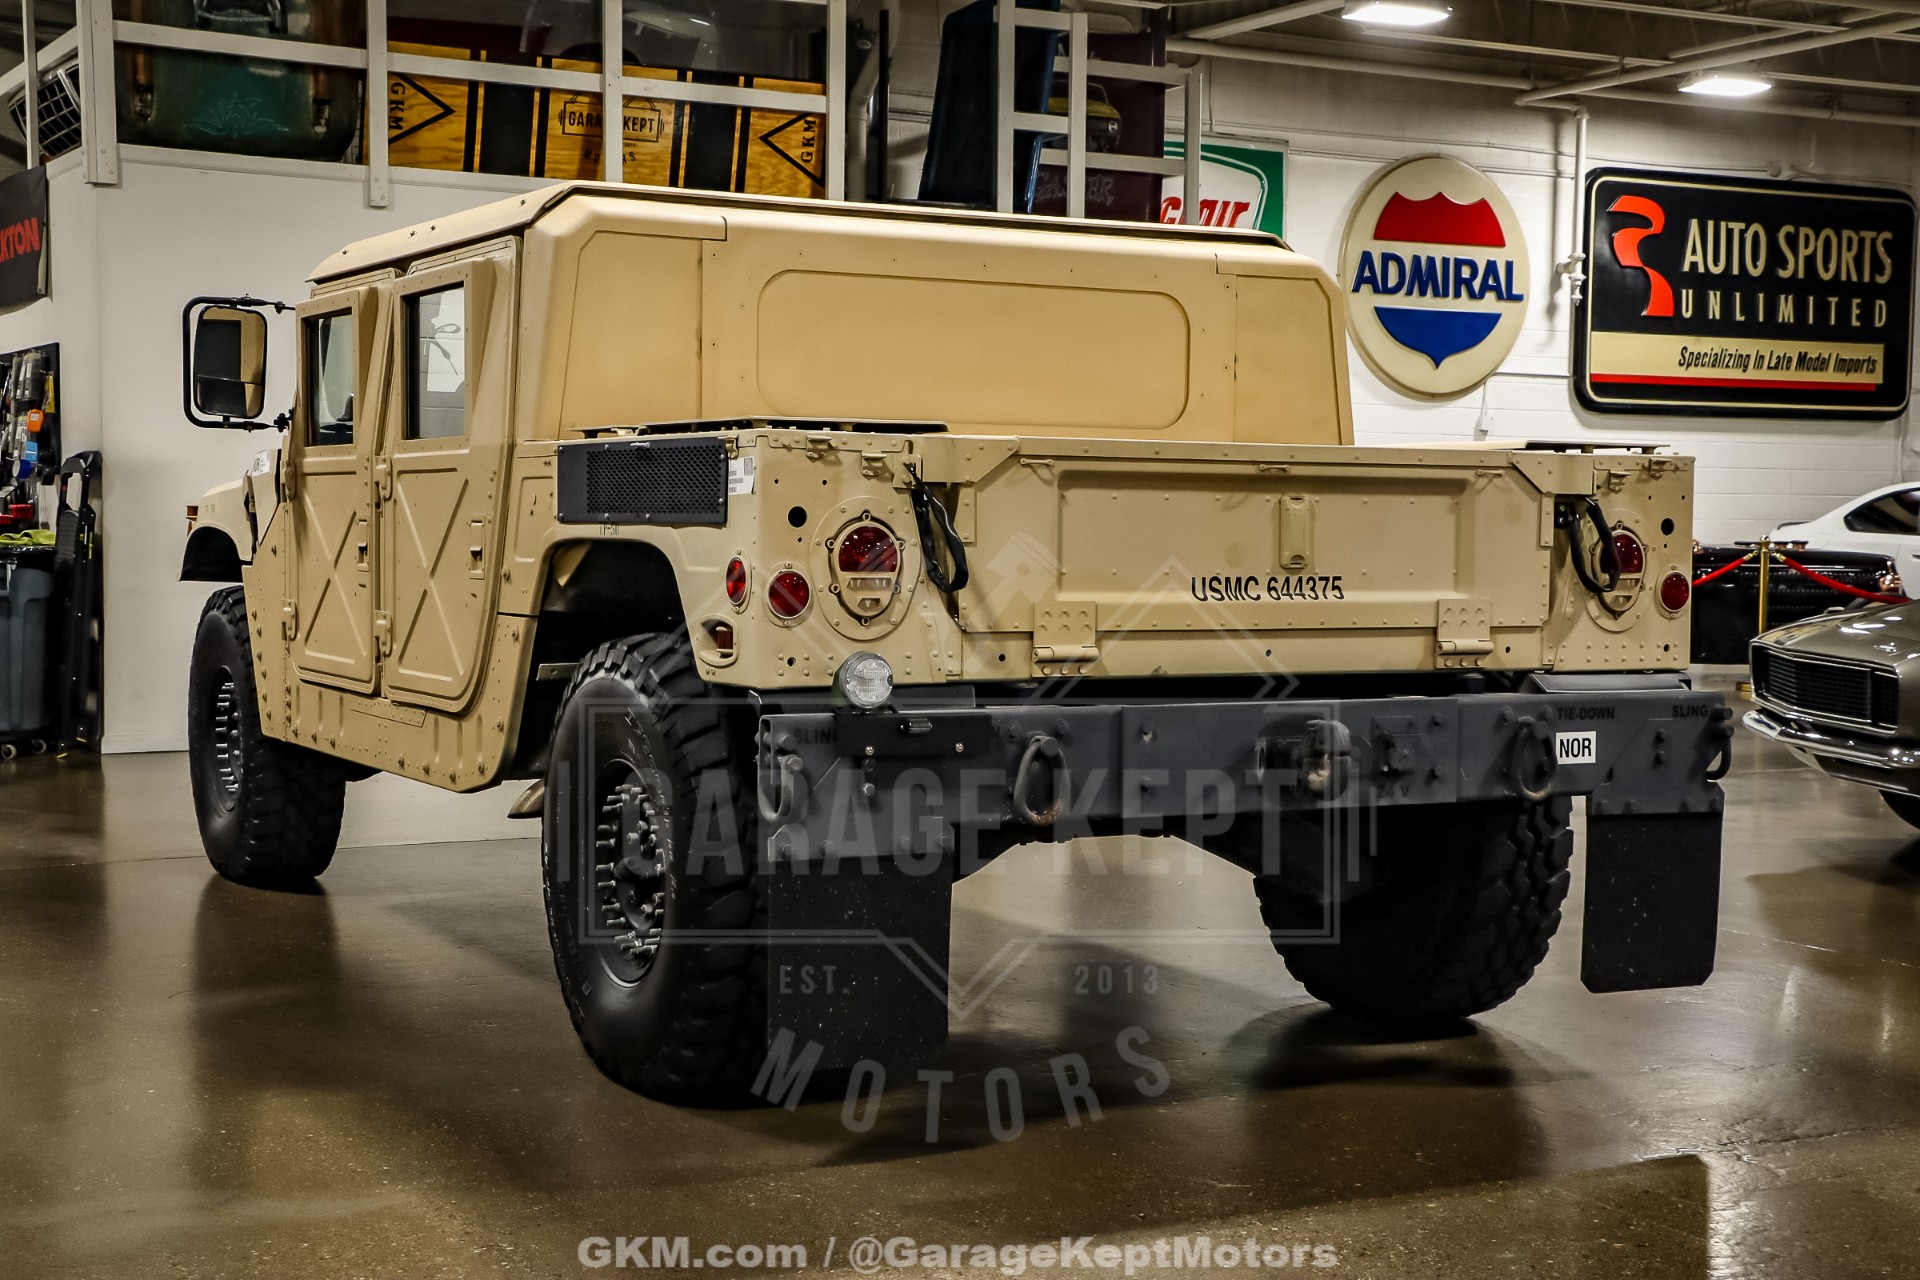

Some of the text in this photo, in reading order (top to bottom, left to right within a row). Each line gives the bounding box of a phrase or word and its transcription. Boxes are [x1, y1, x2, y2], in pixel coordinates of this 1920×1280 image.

[389, 81, 406, 131] GKM
[568, 110, 655, 133] GARA KEPT
[800, 118, 817, 164] GKM
[1682, 218, 1893, 284] AUTO SPORTS
[1351, 250, 1525, 302] ADMIRAL
[1681, 288, 1888, 328] UNLIMITED
[1678, 345, 1877, 376] Specializing In Late Model Imports
[1191, 575, 1345, 602] USMC 644375
[1557, 705, 1616, 721] TIE-DOWN
[1671, 704, 1709, 719] SLING
[1558, 737, 1592, 759] NOR
